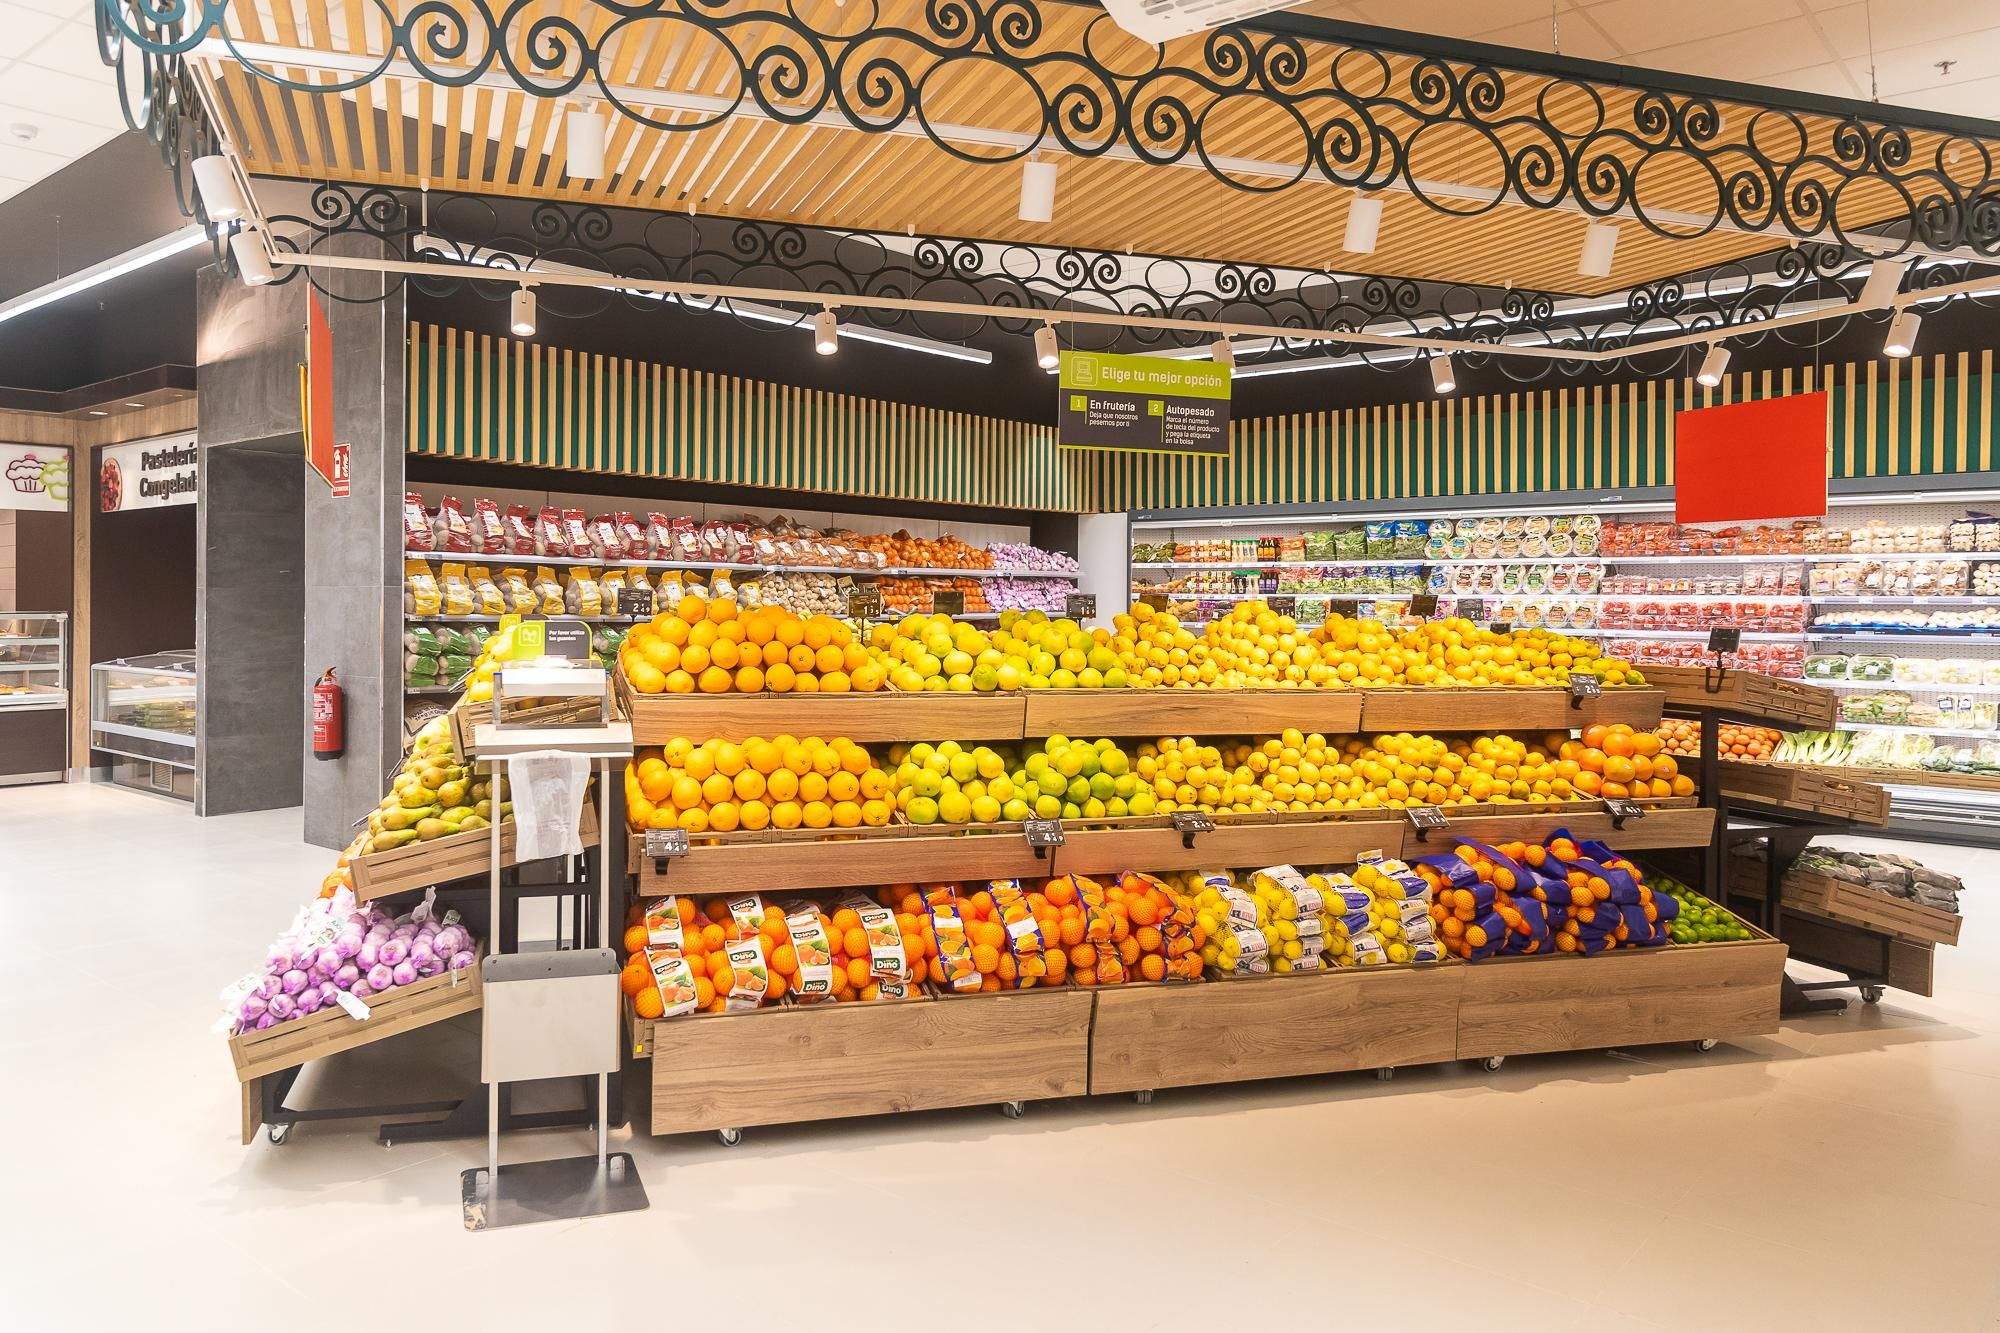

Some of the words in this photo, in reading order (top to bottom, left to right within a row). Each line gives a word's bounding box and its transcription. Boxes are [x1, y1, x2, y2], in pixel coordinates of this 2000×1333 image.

[1102, 366, 1130, 383] Elige
[1134, 370, 1145, 381] tu
[1148, 371, 1182, 385] mejor
[1184, 373, 1222, 388] opción
[1090, 399, 1101, 409] En
[1103, 400, 1136, 411] frutería
[1153, 403, 1159, 412] 2
[1089, 411, 1102, 419] Deja
[1166, 404, 1215, 417] Autopesado
[1188, 417, 1209, 425] número
[1196, 425, 1220, 433] producto
[140, 470, 197, 500] Congelad
